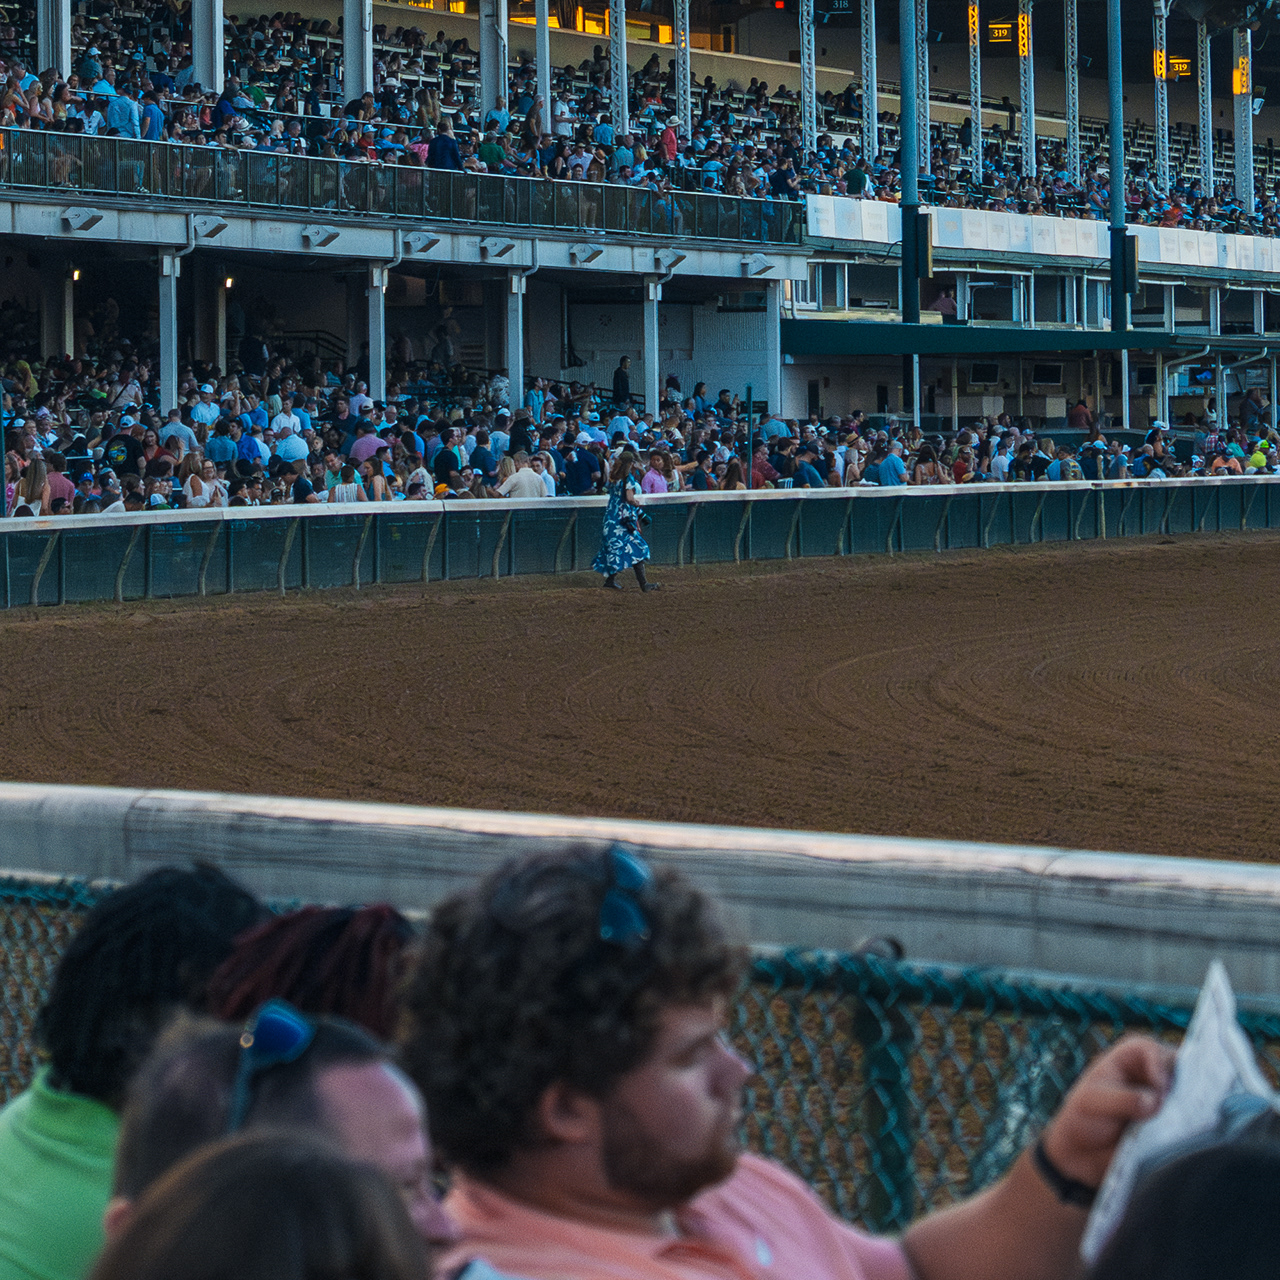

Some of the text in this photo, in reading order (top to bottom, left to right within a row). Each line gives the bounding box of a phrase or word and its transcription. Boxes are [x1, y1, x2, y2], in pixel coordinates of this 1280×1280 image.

[832, 0, 849, 9] 318
[992, 29, 1008, 38] 319
[1173, 63, 1188, 71] 319
